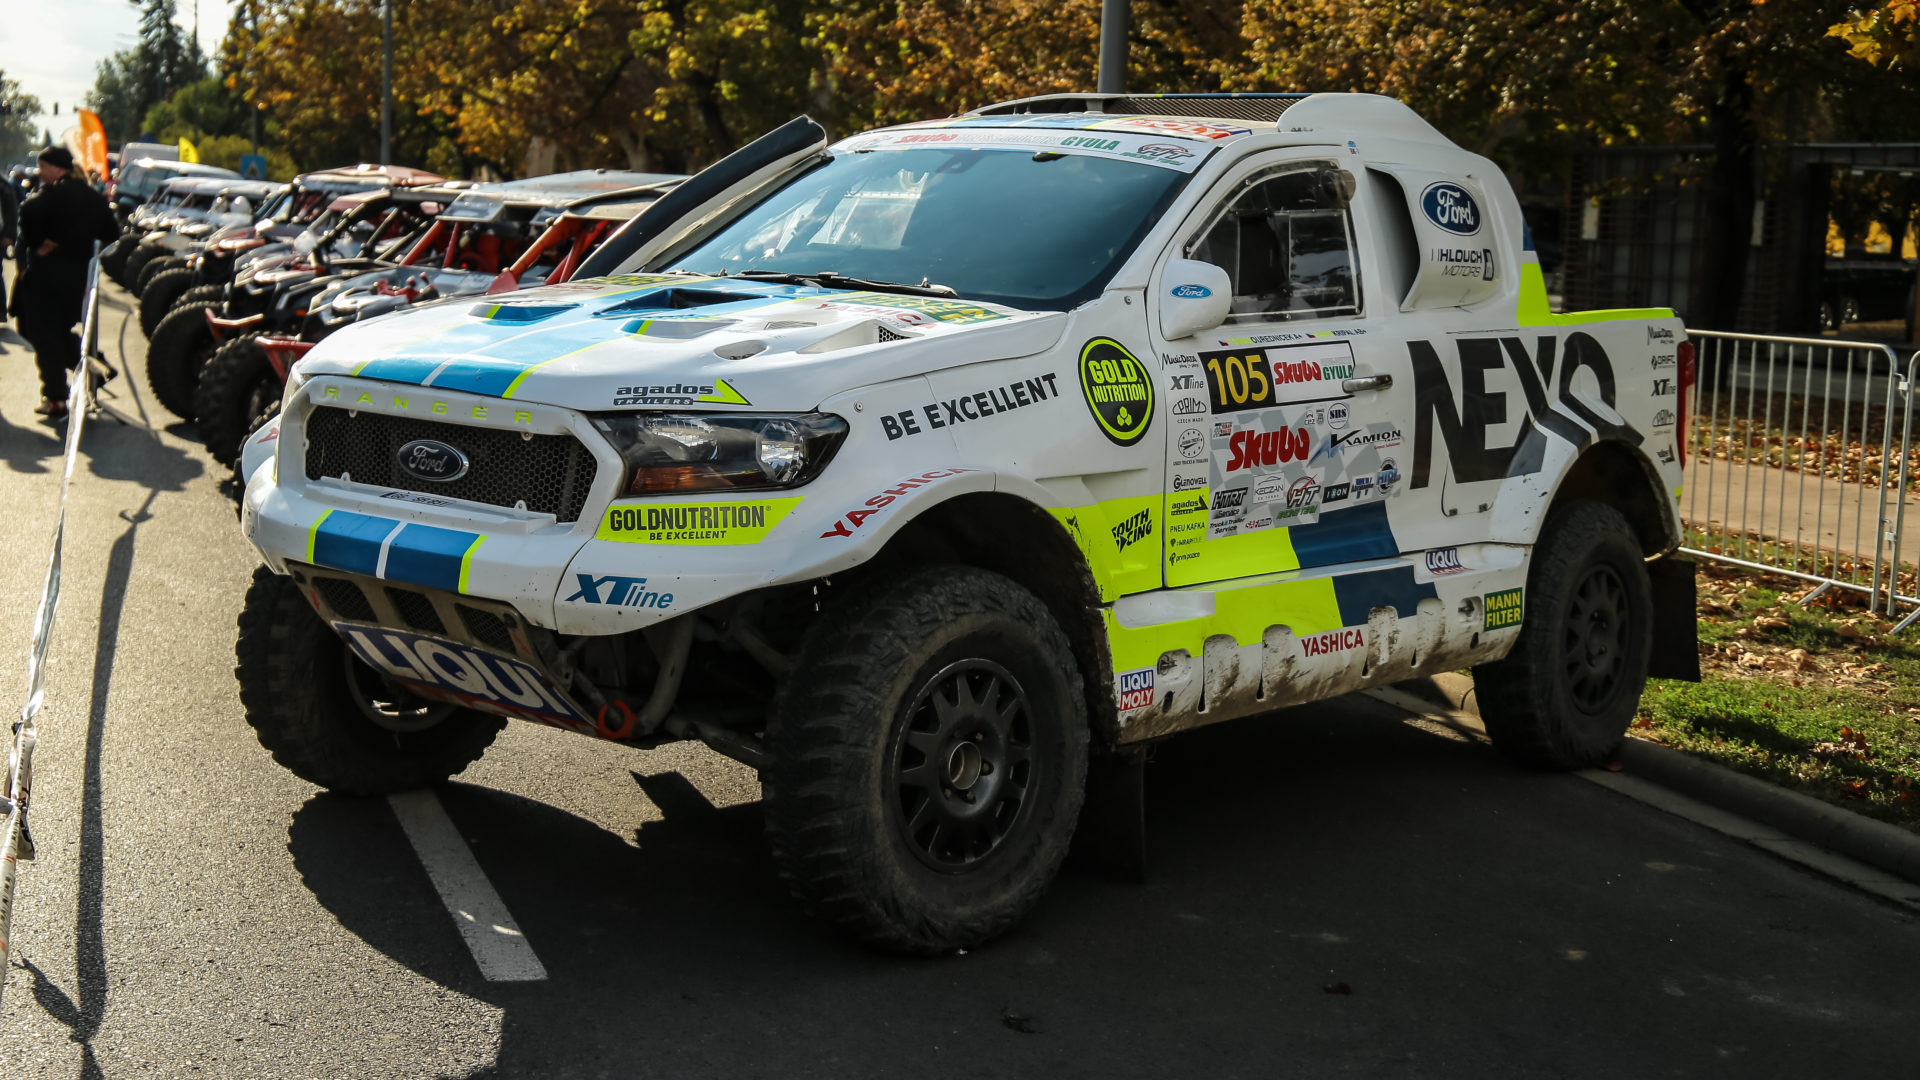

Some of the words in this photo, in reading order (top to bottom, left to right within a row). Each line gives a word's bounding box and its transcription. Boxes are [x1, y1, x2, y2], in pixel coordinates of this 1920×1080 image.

[1060, 136, 1121, 151] GYULA
[1436, 188, 1474, 226] Ford
[1441, 265, 1481, 278] MOTORS
[1177, 285, 1205, 298] Ford
[1088, 359, 1139, 383] GOLD
[1207, 355, 1269, 406] 105
[1323, 364, 1354, 381] GYULA
[616, 383, 714, 397] agados
[1170, 374, 1204, 391] XTline
[614, 397, 694, 406] TRAILERS
[1092, 383, 1147, 403] NUTRITION
[325, 387, 533, 425] RANGER
[880, 410, 921, 441] BE
[923, 372, 1060, 430] EXCELLENT
[1329, 408, 1347, 420] SBS
[1331, 429, 1401, 449] KAMION
[408, 445, 449, 473] Ford
[819, 466, 982, 540] YASHICA
[1171, 499, 1199, 510] agados
[649, 532, 664, 541] BE
[666, 530, 727, 541] EXCELLENT
[1187, 522, 1206, 531] KAFKA
[1426, 549, 1459, 569] LIQUI
[565, 573, 674, 609] XTline
[1486, 591, 1521, 611] MANN
[1486, 606, 1522, 629] FILTER
[1301, 629, 1364, 657] YASHICA
[349, 629, 573, 718] LIQUI
[1121, 670, 1154, 693] LIQUI
[1120, 689, 1154, 710] MOLY
